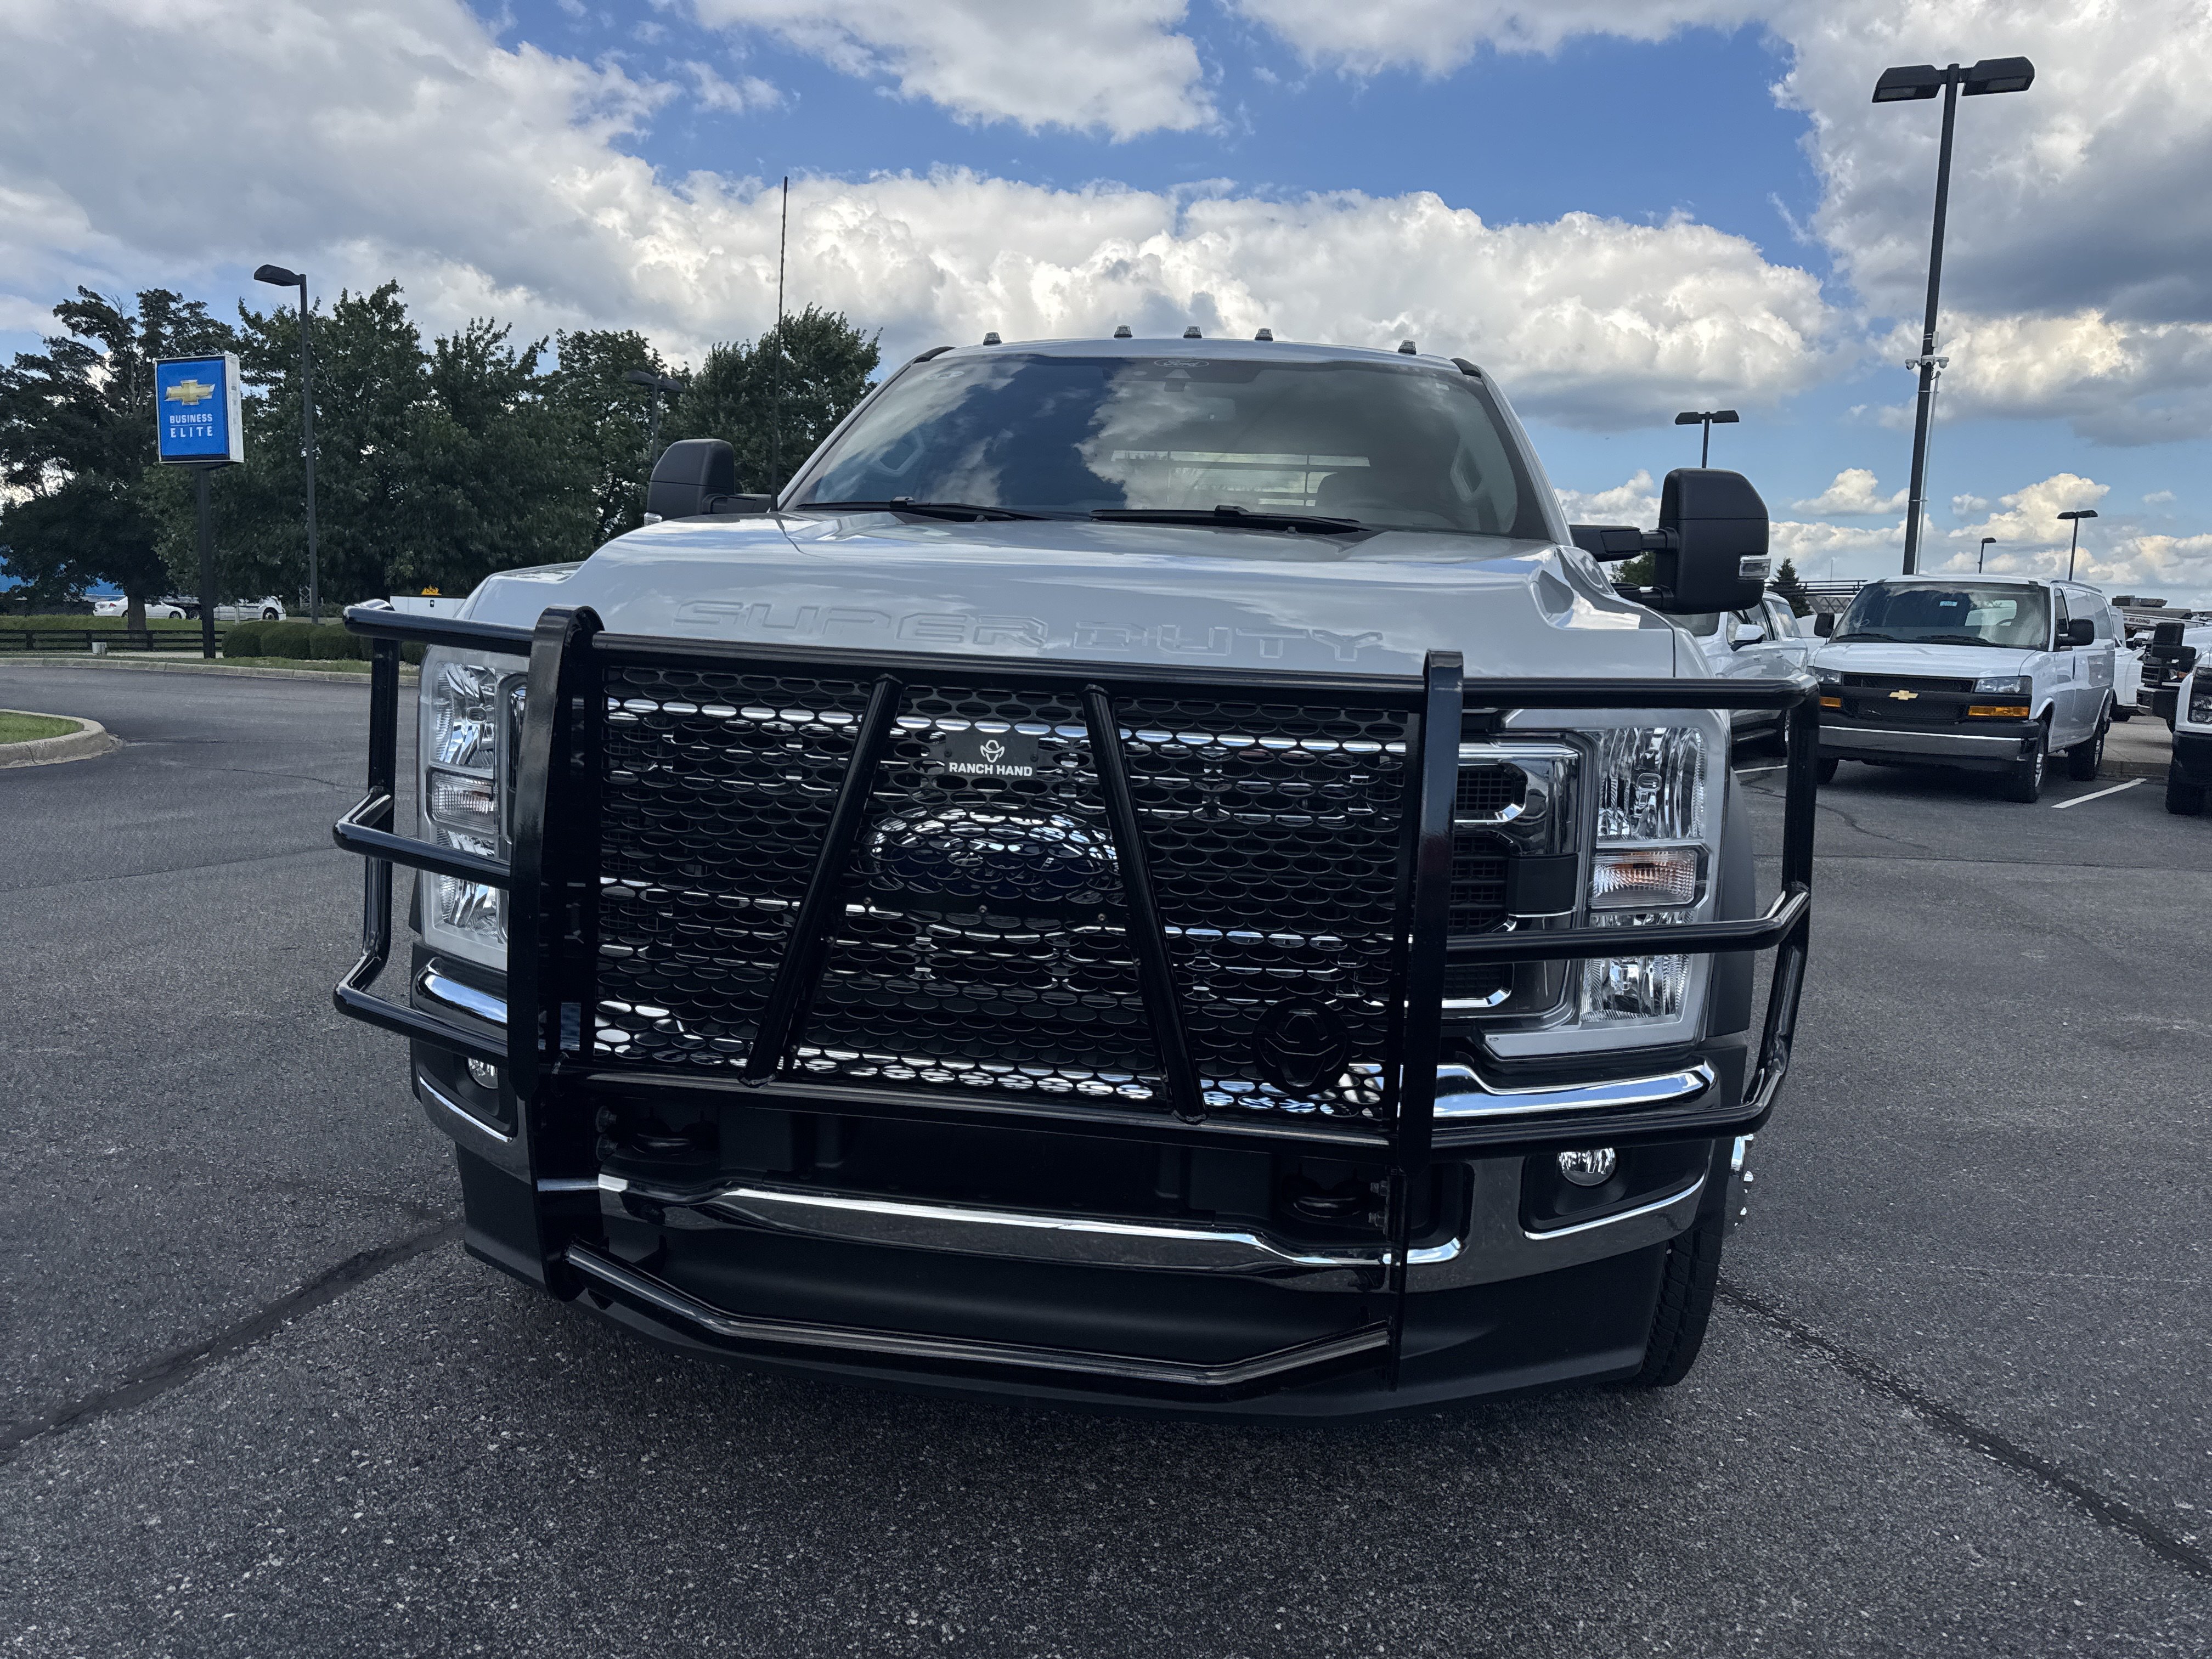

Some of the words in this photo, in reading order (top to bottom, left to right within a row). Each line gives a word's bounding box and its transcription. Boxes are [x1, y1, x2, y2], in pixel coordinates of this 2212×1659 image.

[170, 414, 213, 424] BUSINESS
[171, 426, 213, 438] ELITE
[672, 600, 1048, 648] SUPER
[1074, 620, 1384, 662] DUTY
[949, 762, 994, 775] RANCH
[996, 764, 1032, 776] HAND
